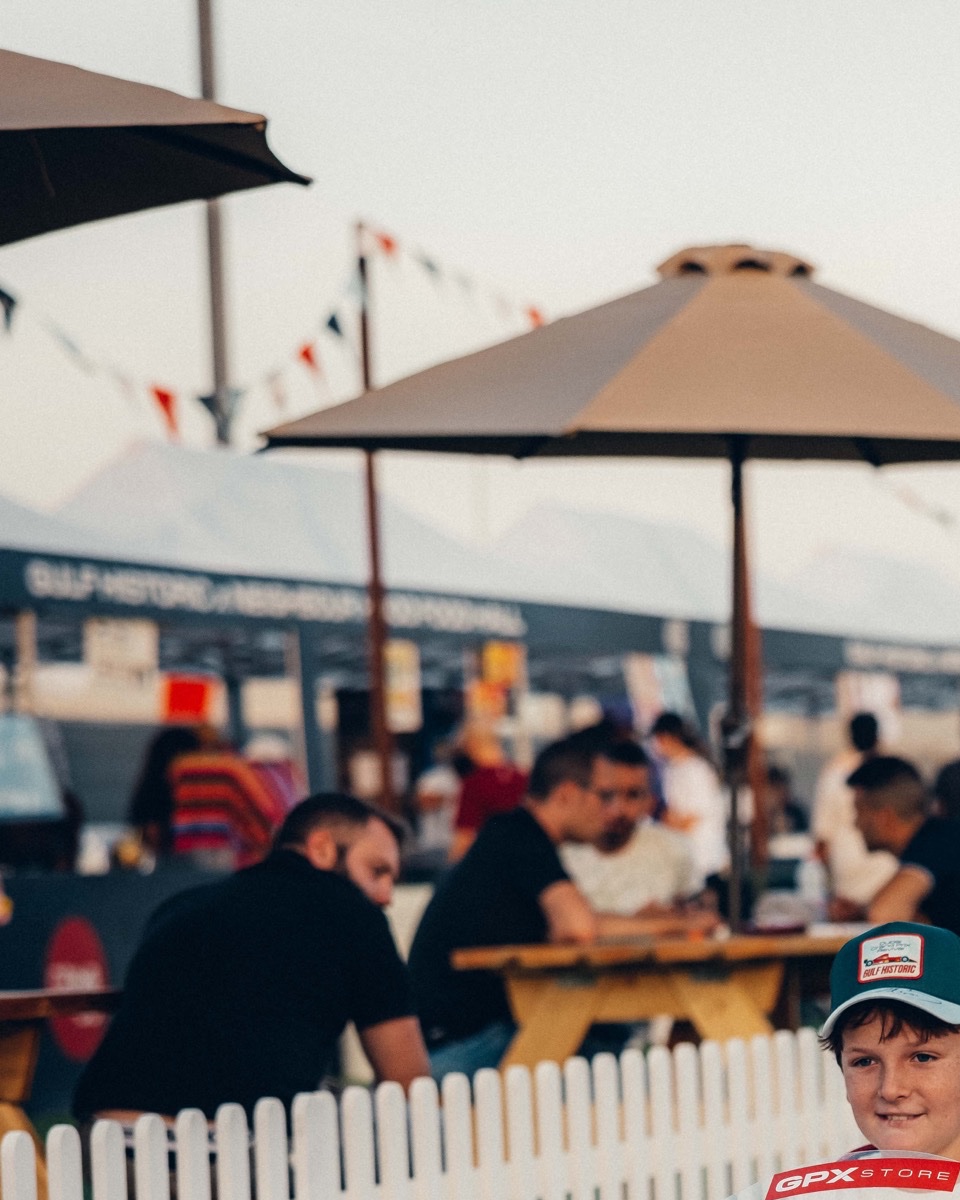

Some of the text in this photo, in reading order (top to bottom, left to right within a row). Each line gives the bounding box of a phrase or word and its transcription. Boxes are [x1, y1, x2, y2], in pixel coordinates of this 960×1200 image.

[863, 964, 917, 978] GULF HISTORIC
[775, 1166, 951, 1193] GPX STORE
